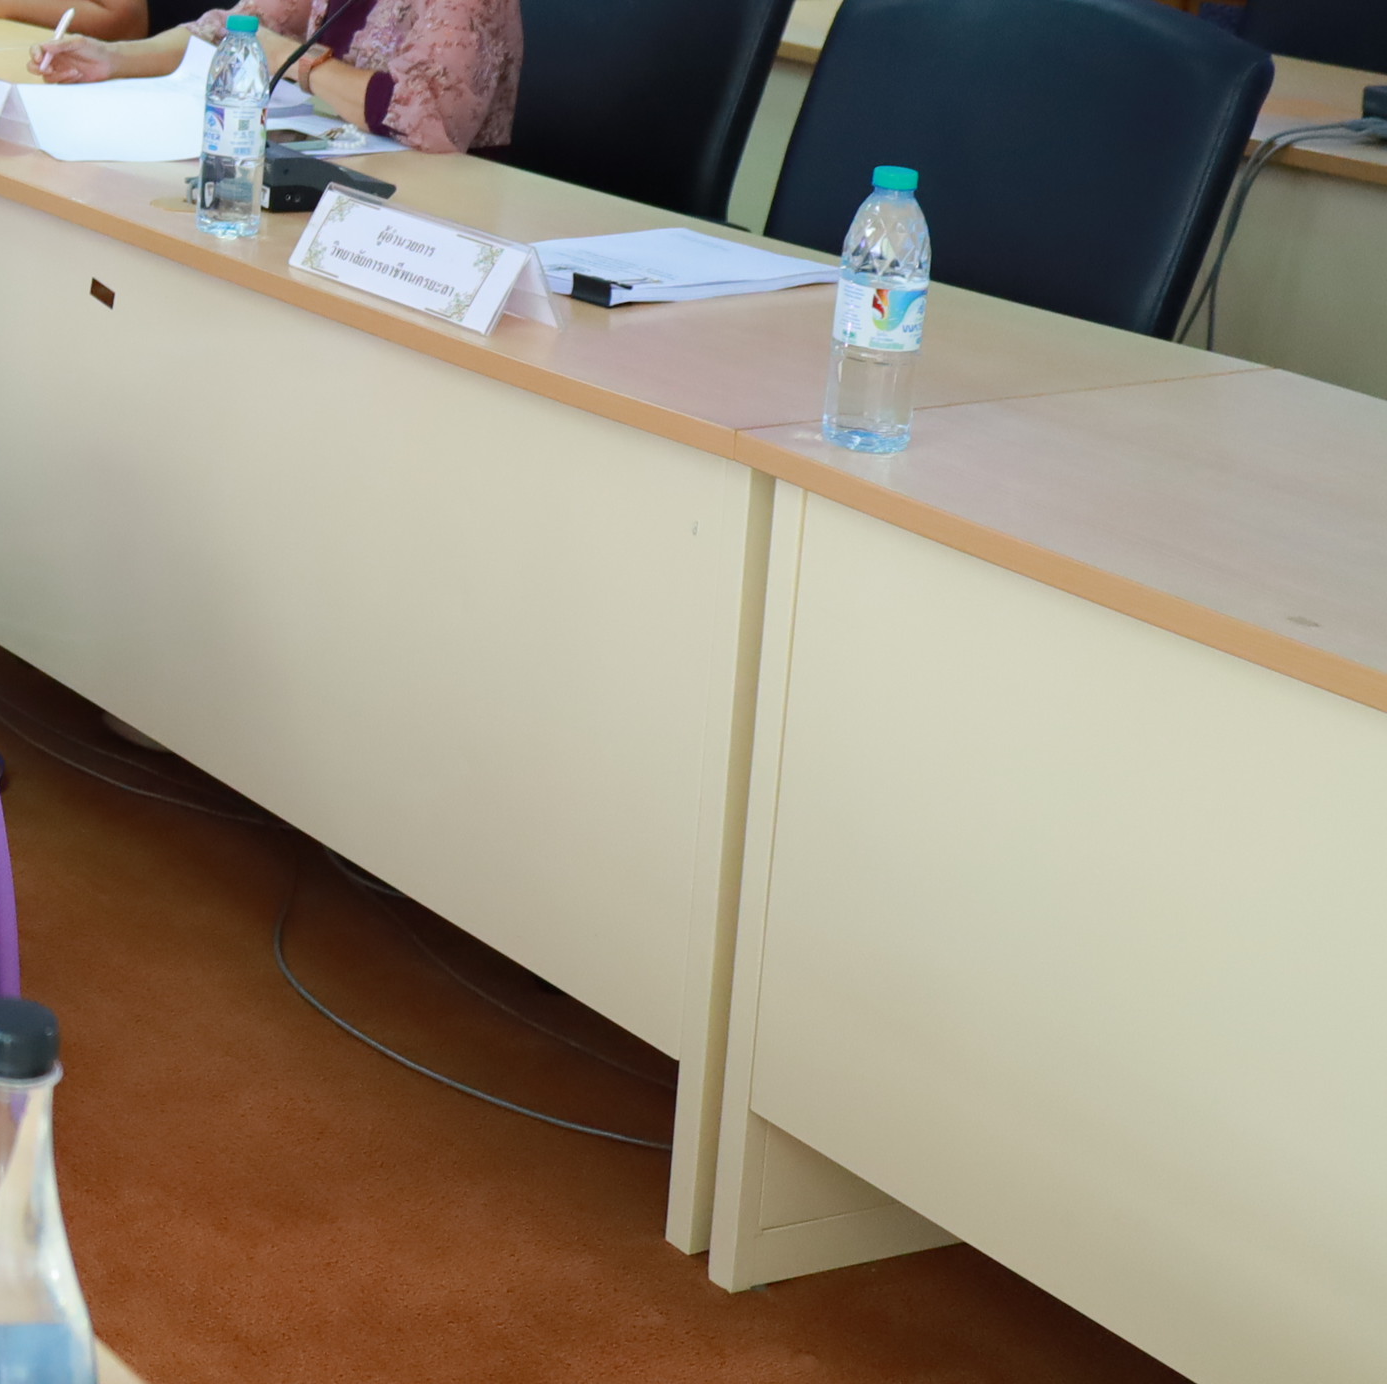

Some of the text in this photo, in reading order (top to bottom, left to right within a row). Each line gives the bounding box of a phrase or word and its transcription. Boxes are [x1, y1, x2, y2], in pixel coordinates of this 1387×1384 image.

[376, 224, 437, 258] ผู้อำนวยการ
[329, 240, 456, 298] วิทยาลัยการอาชีพนครยะลา
